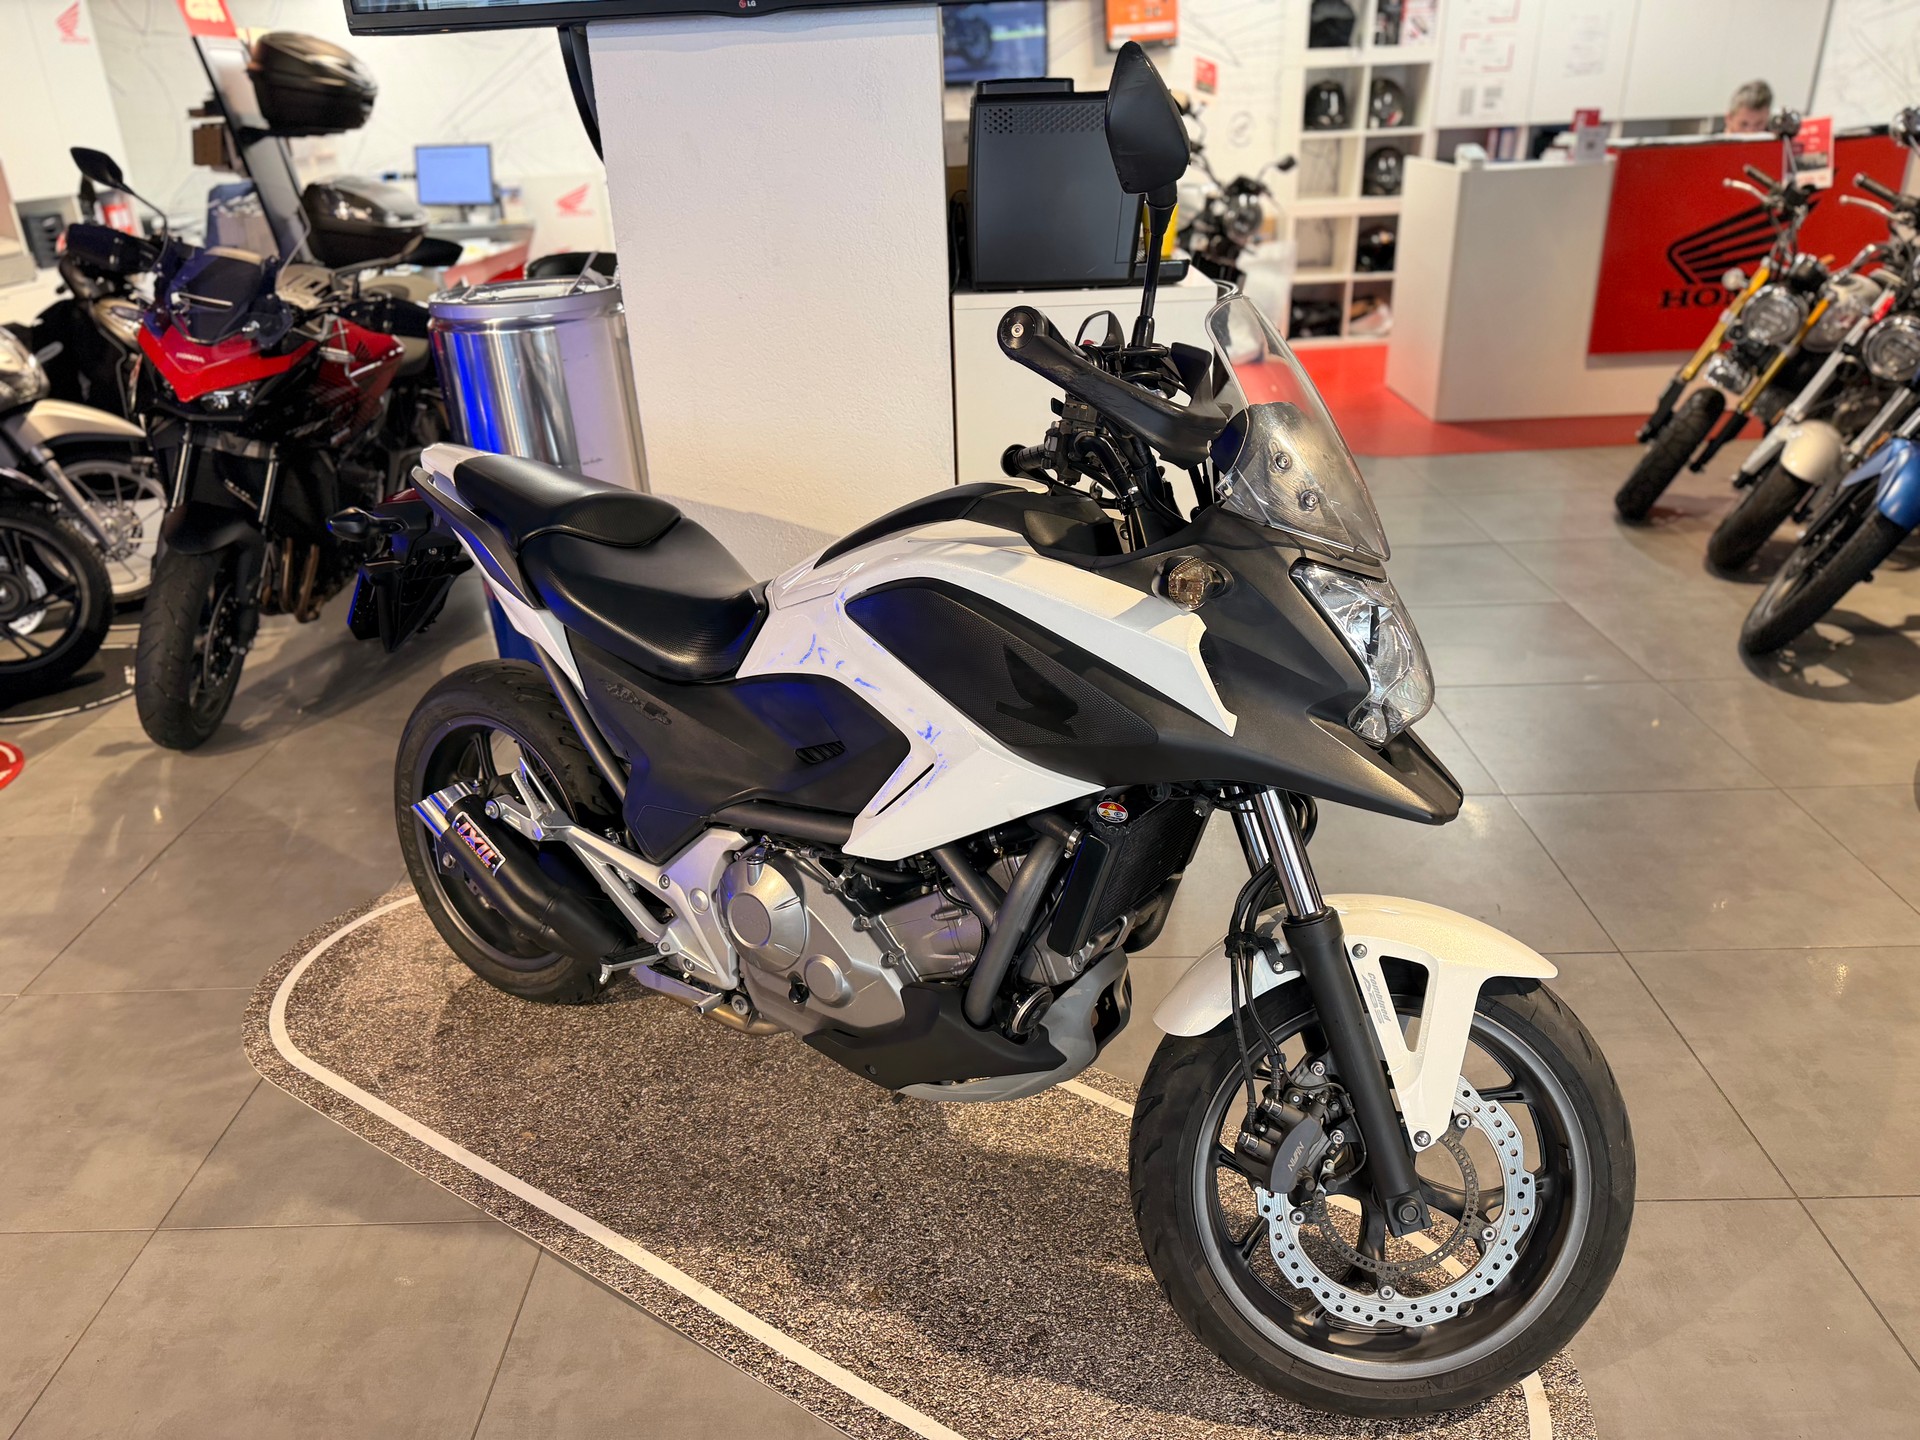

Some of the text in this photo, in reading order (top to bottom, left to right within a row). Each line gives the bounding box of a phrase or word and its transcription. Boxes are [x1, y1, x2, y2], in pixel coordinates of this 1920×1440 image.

[458, 821, 496, 866] IXIL
[1361, 974, 1385, 1024] ABS
[1367, 972, 1391, 1022] Combined
